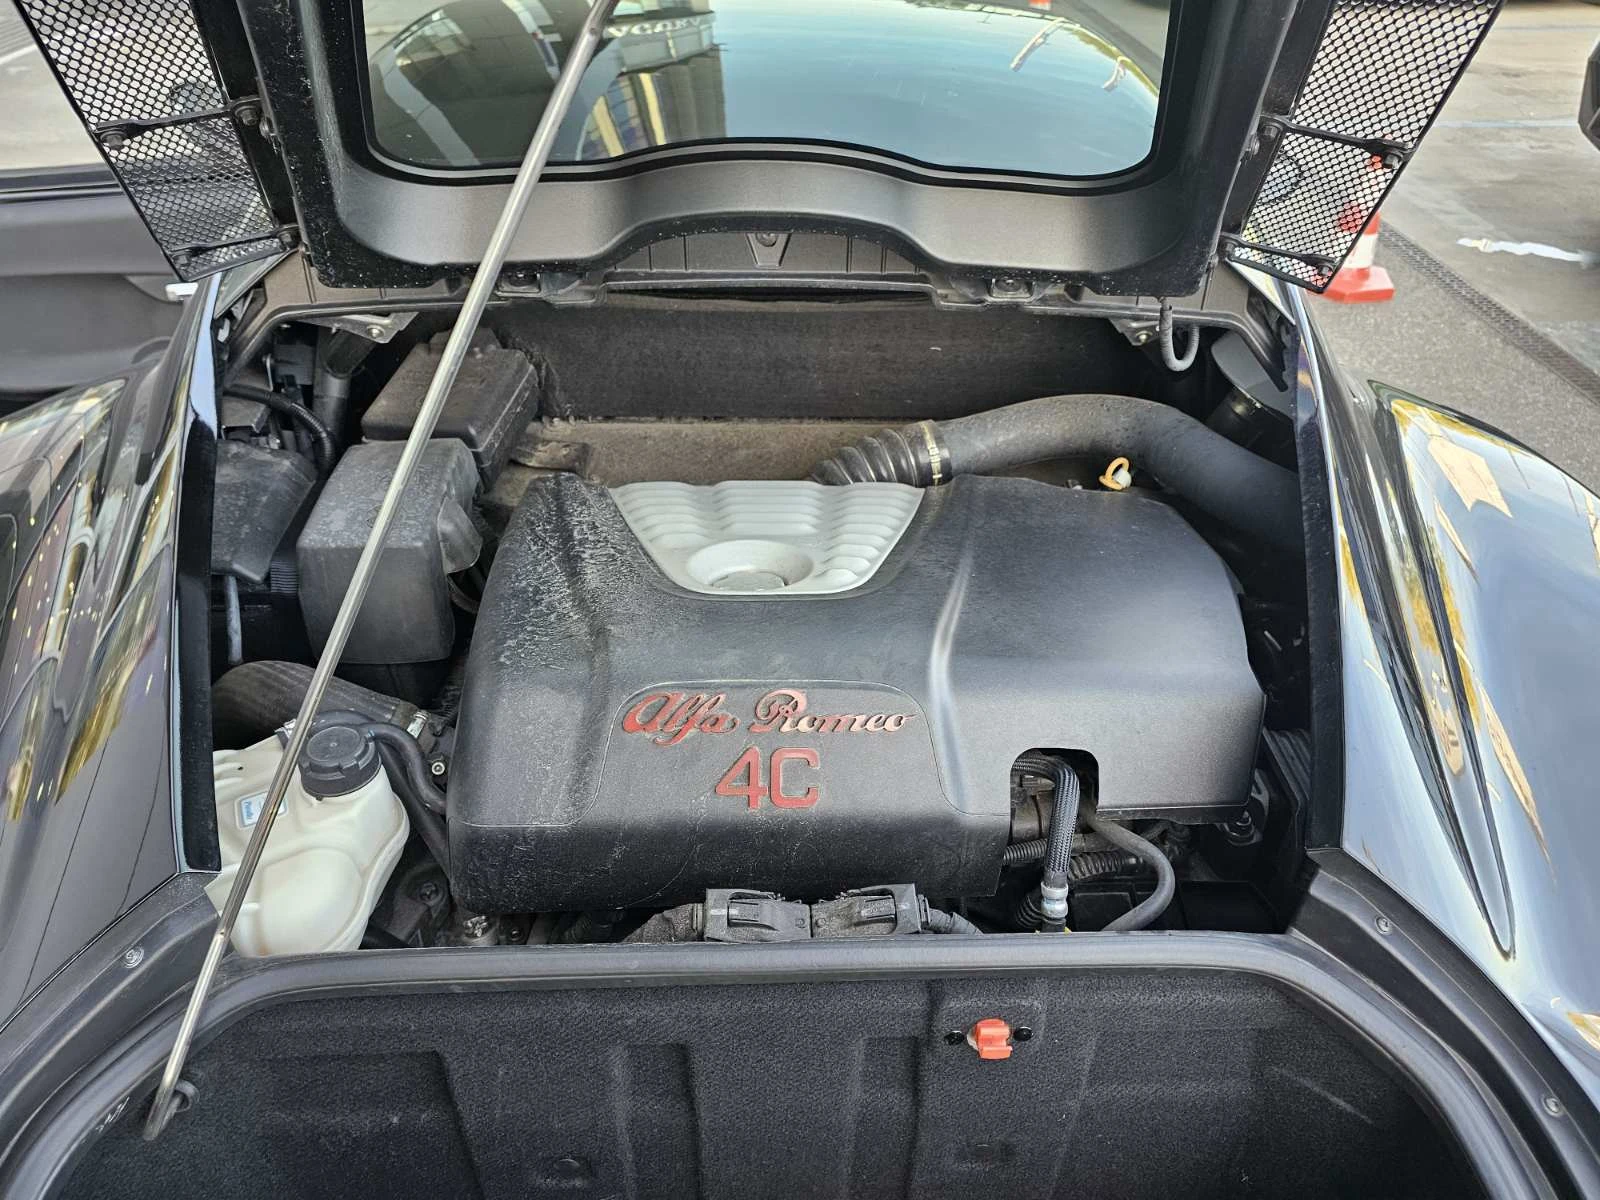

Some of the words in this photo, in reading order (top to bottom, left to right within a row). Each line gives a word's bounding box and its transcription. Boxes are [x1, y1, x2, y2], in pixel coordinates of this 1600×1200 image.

[621, 691, 740, 746] Alfa
[748, 688, 914, 733] Romeo
[715, 746, 820, 809] 4C
